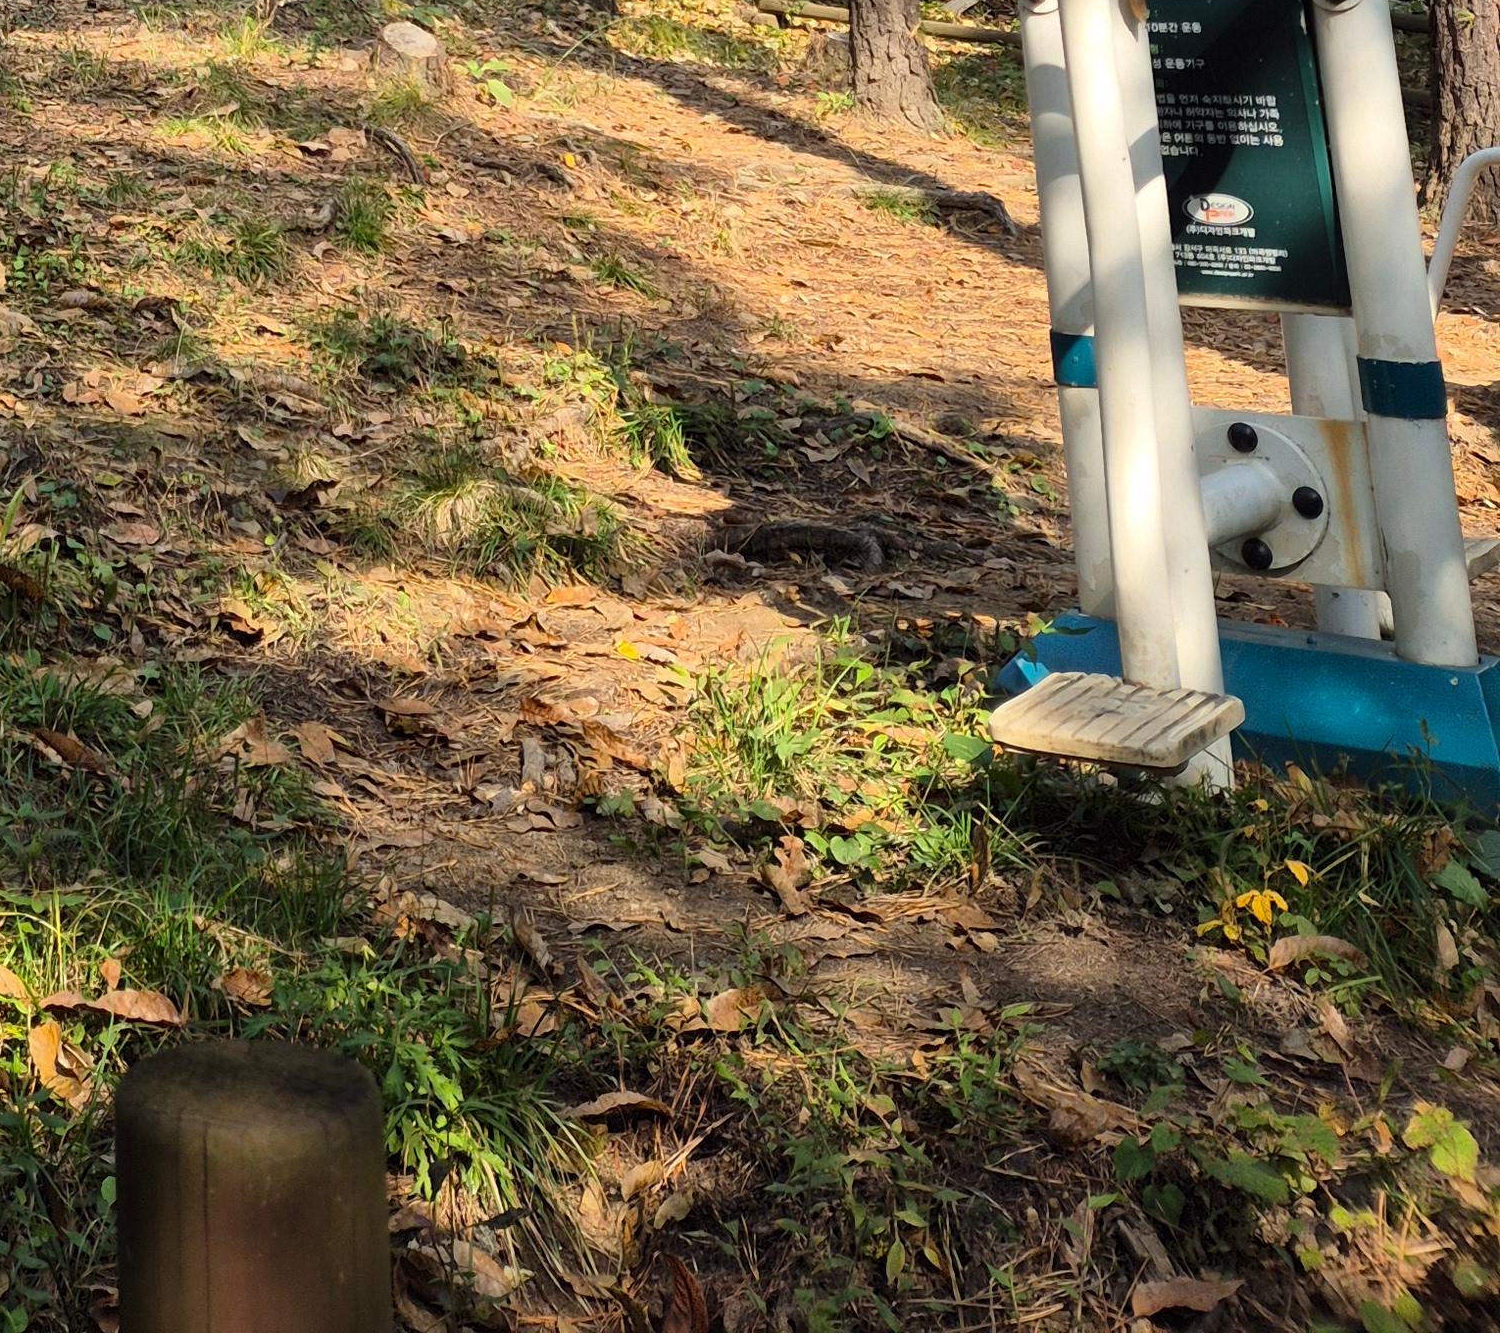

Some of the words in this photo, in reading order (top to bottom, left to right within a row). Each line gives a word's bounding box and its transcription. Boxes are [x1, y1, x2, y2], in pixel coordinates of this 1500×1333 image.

[1181, 21, 1202, 34] 운동
[1165, 58, 1205, 70] 운동기구
[1179, 94, 1199, 105] 먼저
[1227, 108, 1256, 119] 의사나
[1186, 120, 1214, 131] 기구를
[1207, 133, 1227, 145] 동반
[1229, 134, 1260, 146] 없이는
[1263, 134, 1284, 147] 사용
